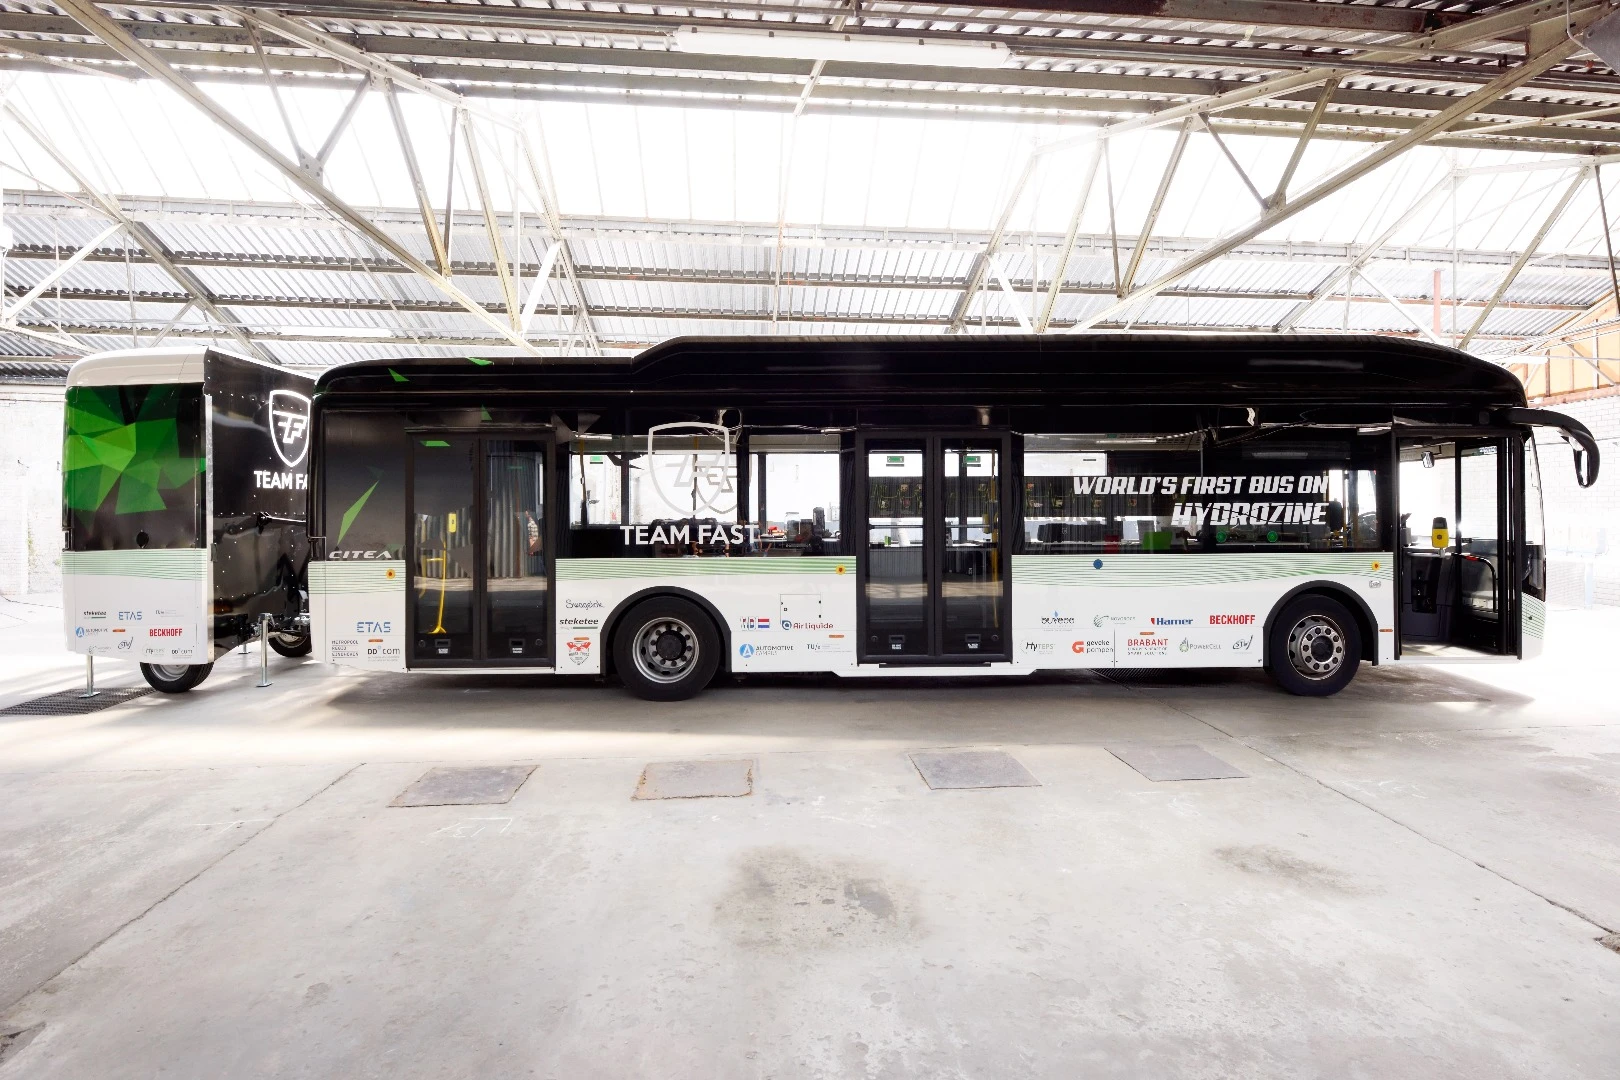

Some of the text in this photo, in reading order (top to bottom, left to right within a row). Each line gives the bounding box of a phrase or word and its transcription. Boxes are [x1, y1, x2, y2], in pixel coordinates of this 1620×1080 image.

[253, 470, 293, 490] TEAM
[1073, 475, 1330, 495] WORLD'S FIRST BUS ON
[1170, 502, 1330, 526] HYDROZINE
[620, 524, 759, 545] TEAM FAST
[328, 550, 392, 559] CITEA
[118, 611, 143, 621] ETAS
[1209, 614, 1256, 625] BECKHOFF
[559, 617, 599, 625] steketee
[1156, 617, 1194, 626] Hamer
[356, 621, 391, 633] ETAS
[793, 622, 834, 631] Air Liquide
[149, 628, 183, 637] BECKHOFF
[1127, 638, 1169, 646] BRABANT
[1086, 646, 1114, 654] pompen
